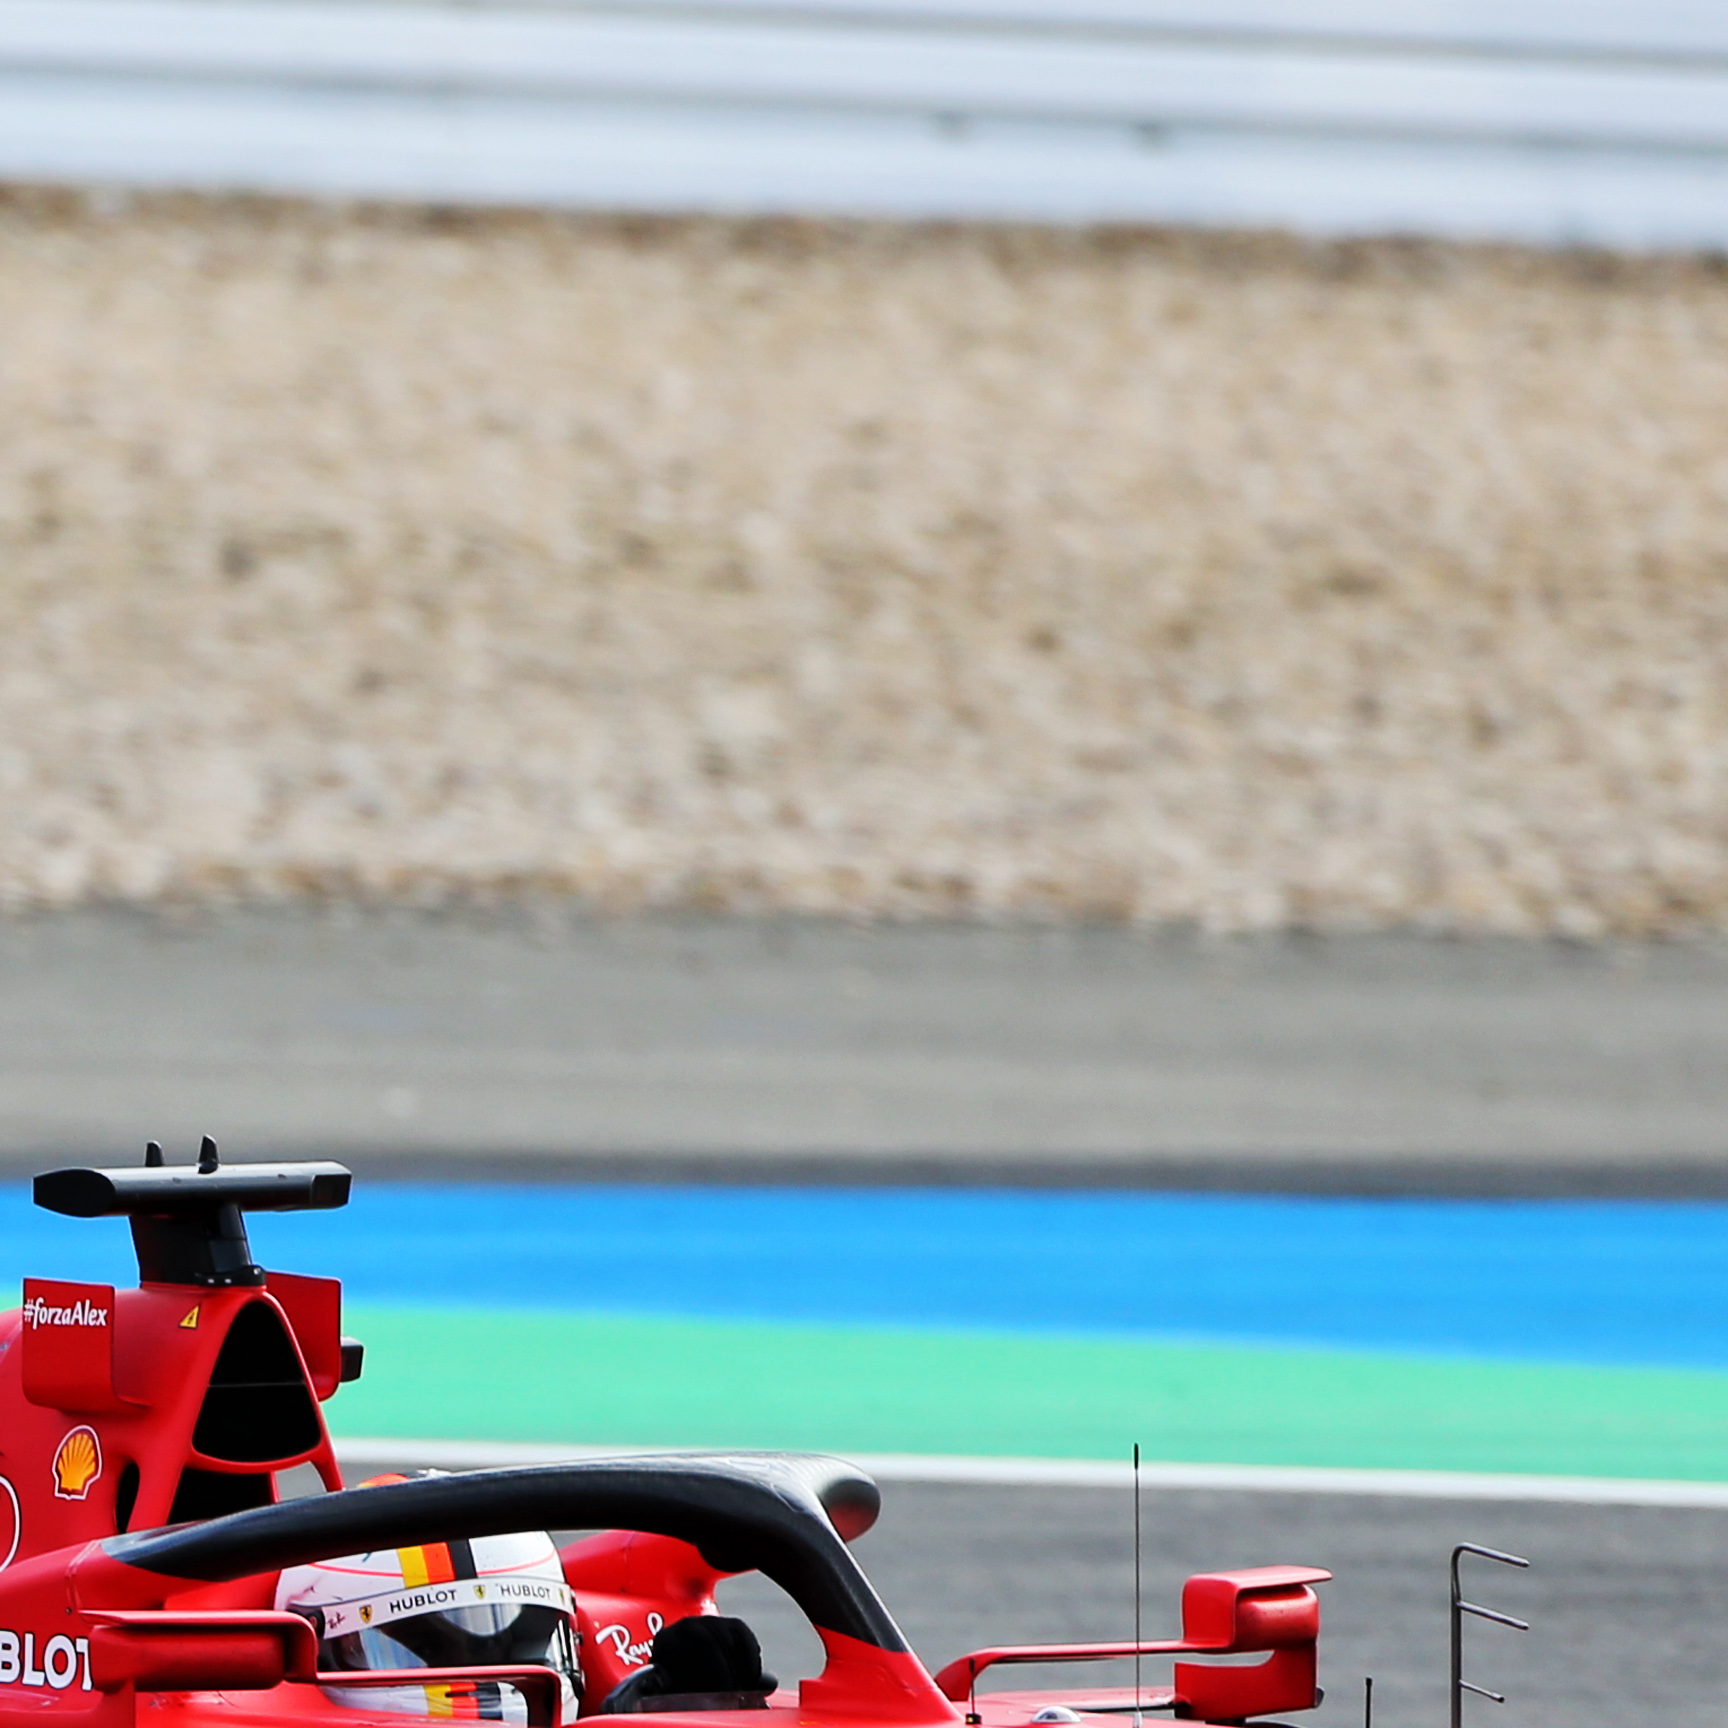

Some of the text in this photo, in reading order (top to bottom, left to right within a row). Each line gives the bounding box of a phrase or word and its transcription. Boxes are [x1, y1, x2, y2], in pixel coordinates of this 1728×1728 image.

[22, 1296, 108, 1331] #forzaAlex
[388, 1589, 458, 1613] HUBLOT
[499, 1583, 551, 1600] HUBLOT
